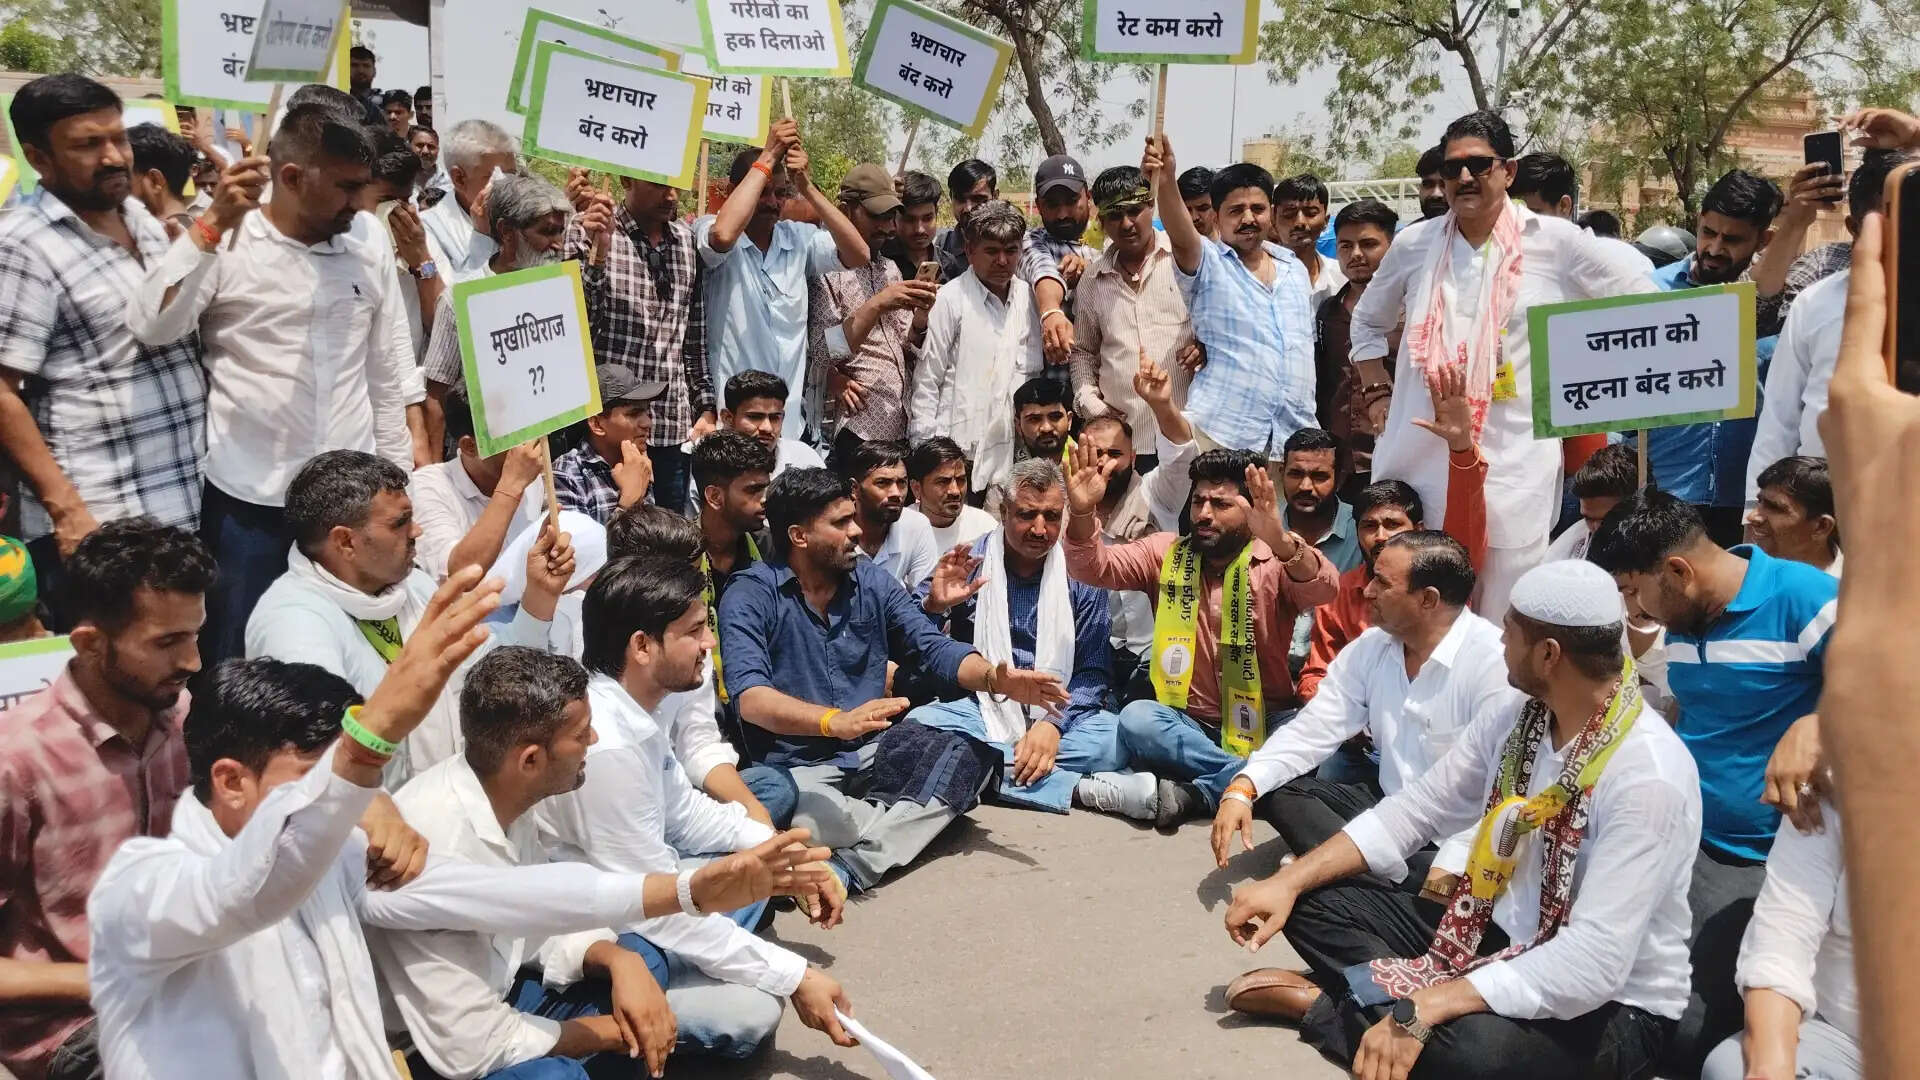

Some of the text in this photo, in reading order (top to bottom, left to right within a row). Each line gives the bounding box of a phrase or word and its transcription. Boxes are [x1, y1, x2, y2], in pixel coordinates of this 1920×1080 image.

[784, 4, 809, 20] का
[1116, 10, 1224, 39] रेट कम करो
[724, 27, 825, 52] हक दिलाओ
[910, 30, 968, 68] भ्रष्टाचार
[222, 52, 246, 77] बं
[584, 78, 658, 111] भ्रष्टाचार
[731, 76, 753, 96] को
[898, 62, 955, 100] बंद करो
[726, 101, 743, 121] दो
[578, 117, 649, 150] बंद करो
[489, 312, 566, 366] मुर्खाधिराज
[1585, 312, 1701, 353] जनता को
[528, 365, 546, 396] ??
[1562, 358, 1727, 411] लूटना बंद करो
